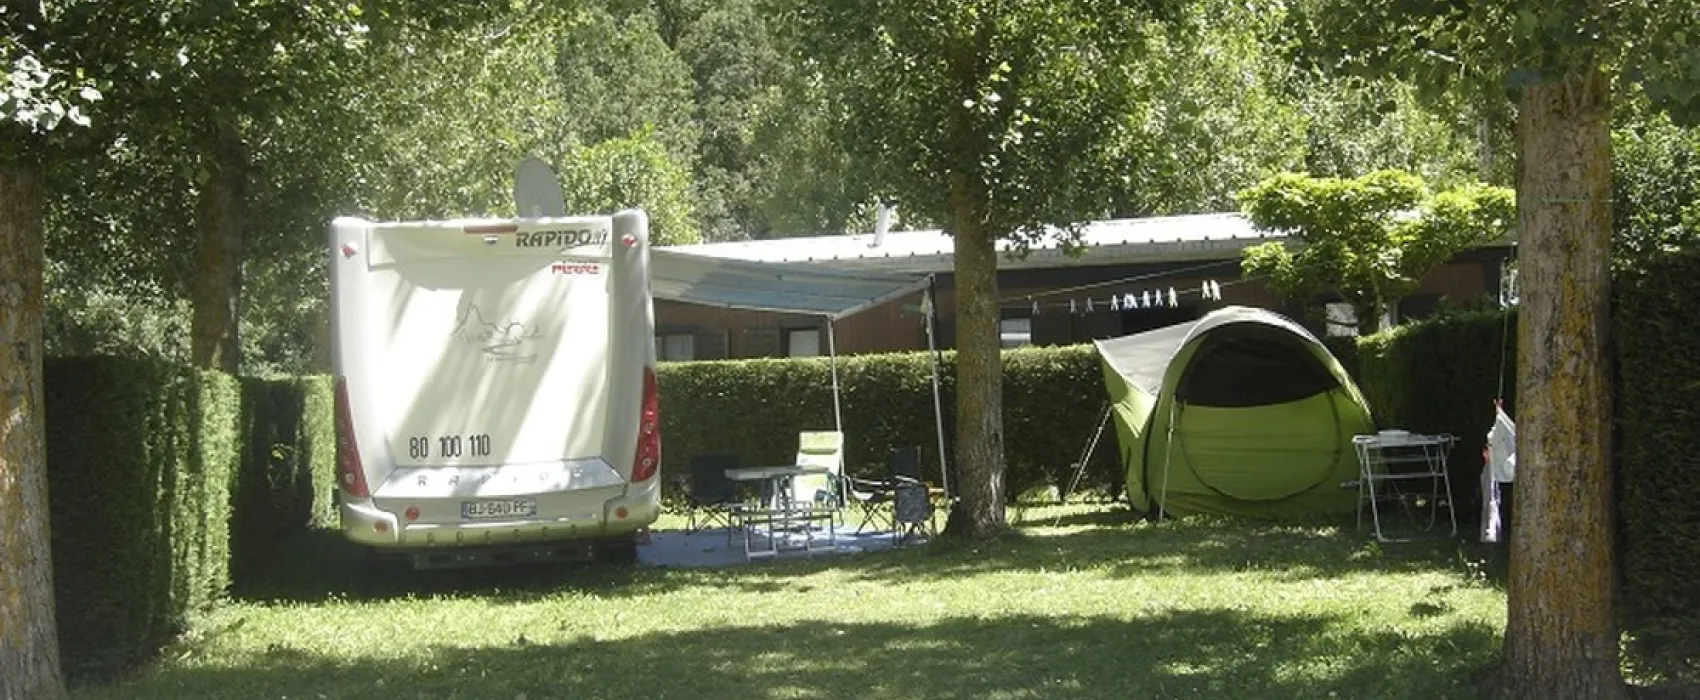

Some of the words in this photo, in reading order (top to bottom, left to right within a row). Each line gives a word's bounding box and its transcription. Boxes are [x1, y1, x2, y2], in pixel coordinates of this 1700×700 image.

[409, 436, 429, 459] 80
[439, 435, 462, 458] 100
[469, 434, 491, 456] 110
